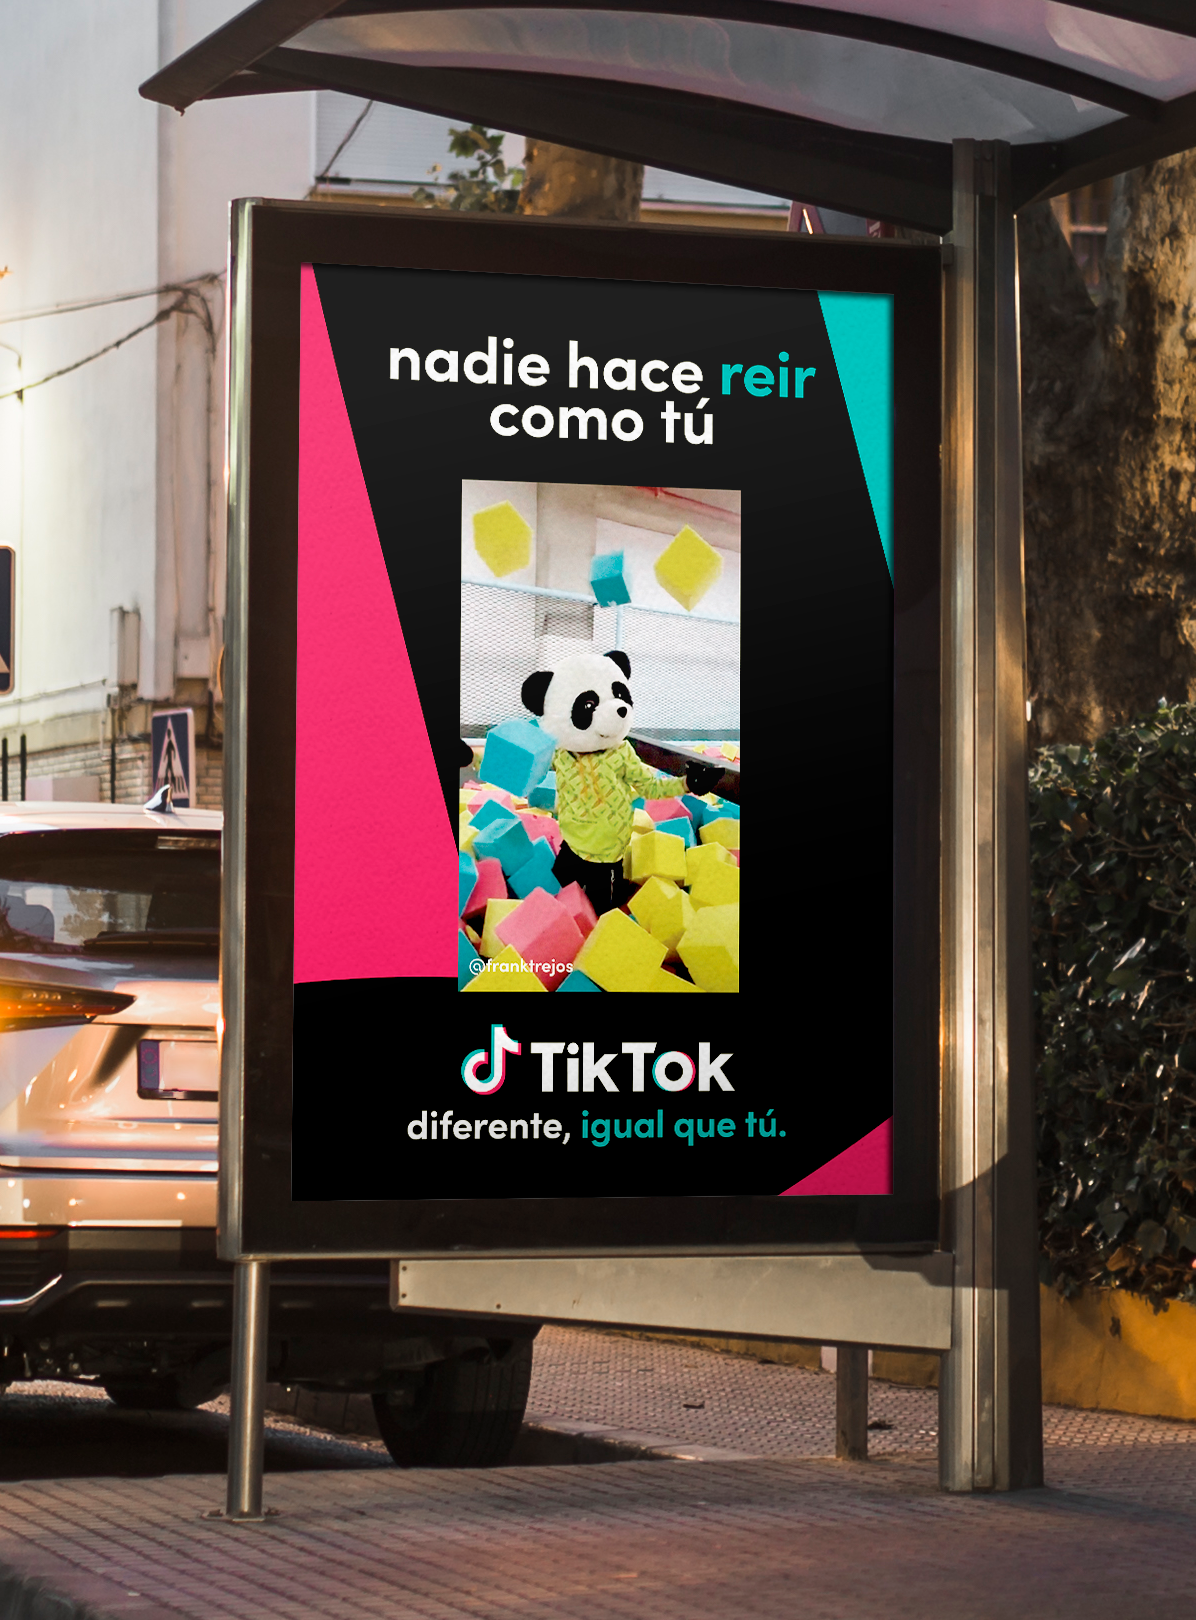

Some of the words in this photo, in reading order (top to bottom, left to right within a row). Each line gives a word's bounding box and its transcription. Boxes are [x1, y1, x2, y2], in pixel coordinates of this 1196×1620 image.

[389, 336, 551, 386] nadie
[568, 340, 704, 394] hace
[721, 351, 816, 399] reir
[490, 403, 644, 442] como
[660, 397, 714, 445] tú
[469, 958, 574, 978] @franktrejos
[530, 1041, 735, 1093] TikTok
[407, 1110, 571, 1145] diferente,
[581, 1109, 663, 1147] igual
[674, 1117, 736, 1147] que
[745, 1109, 787, 1138] tú.
